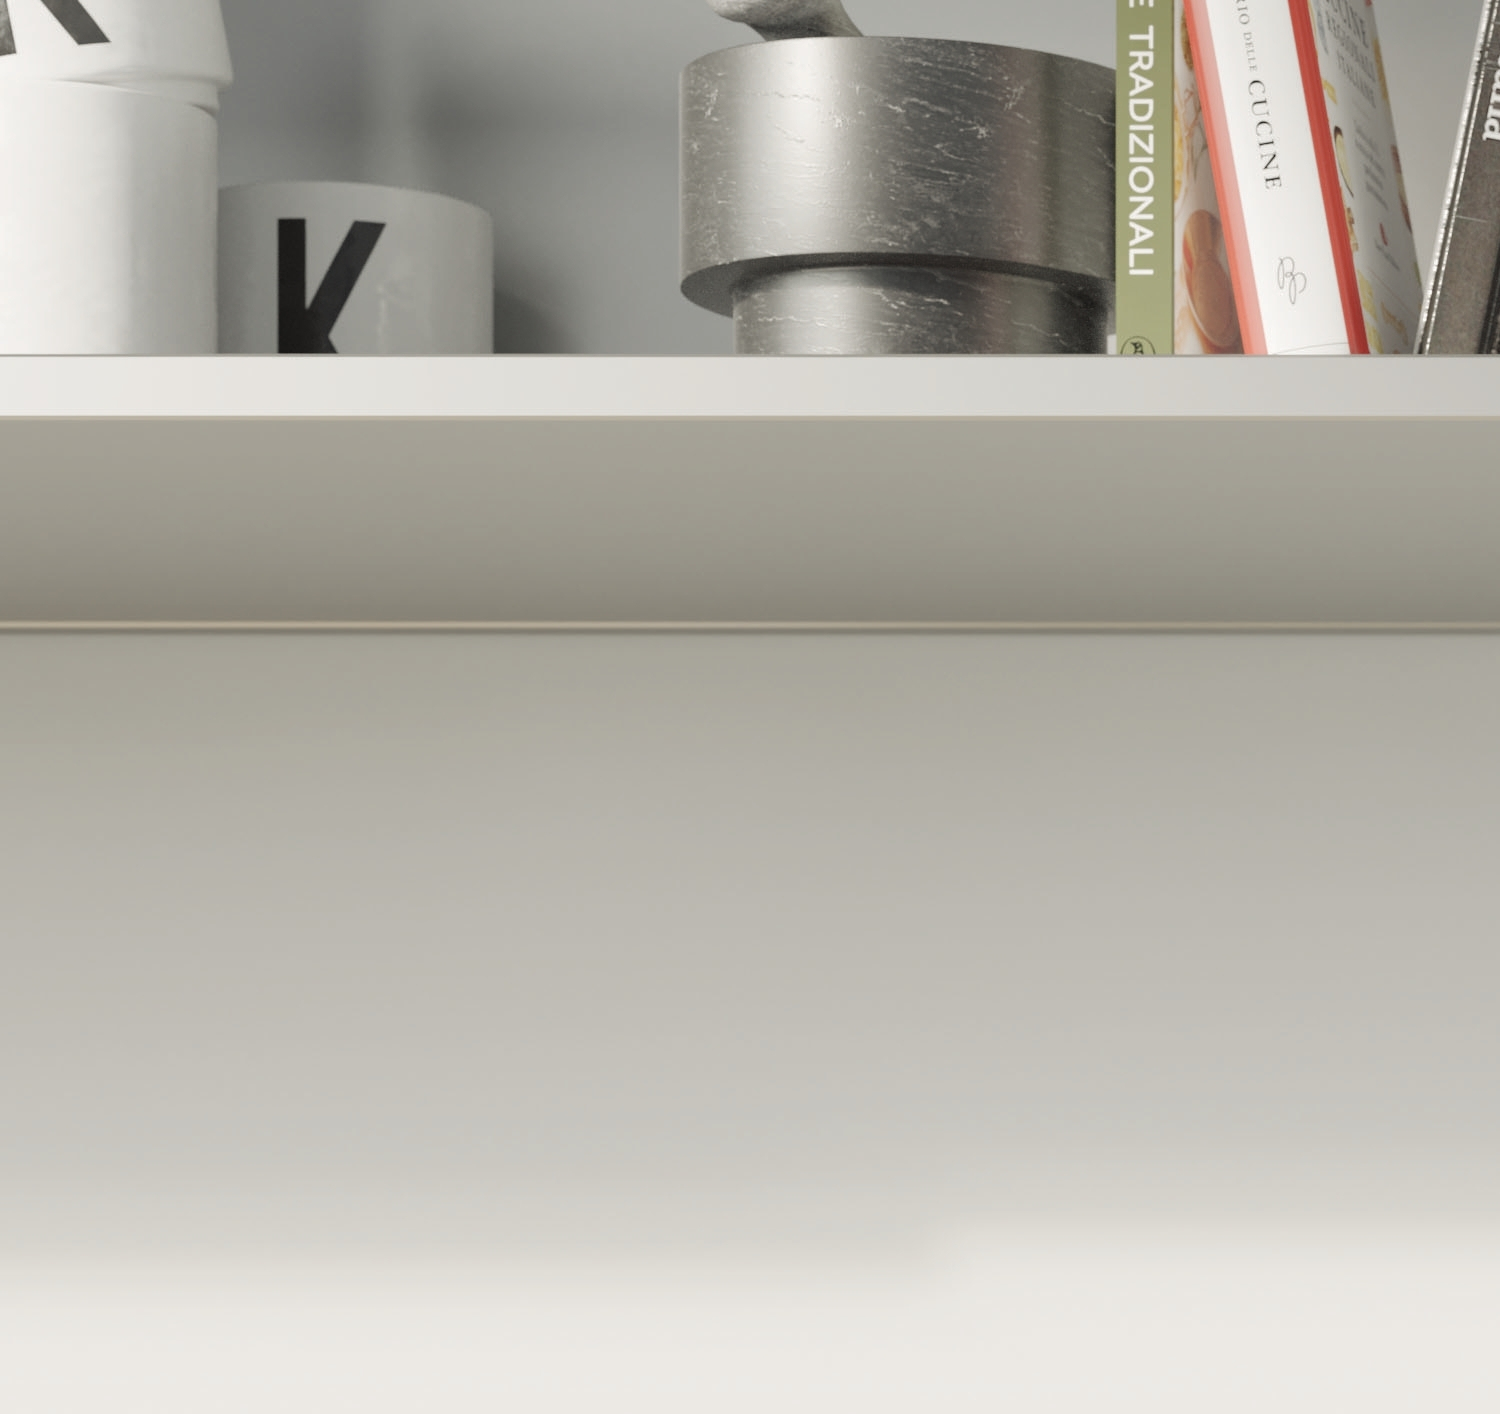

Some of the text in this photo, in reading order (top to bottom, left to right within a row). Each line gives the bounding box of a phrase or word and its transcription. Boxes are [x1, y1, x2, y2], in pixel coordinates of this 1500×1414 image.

[1242, 32, 1257, 71] DELLE
[1128, 25, 1154, 275] TRADIZIONALI
[1248, 80, 1282, 189] CUCINE
[278, 218, 386, 353] K
